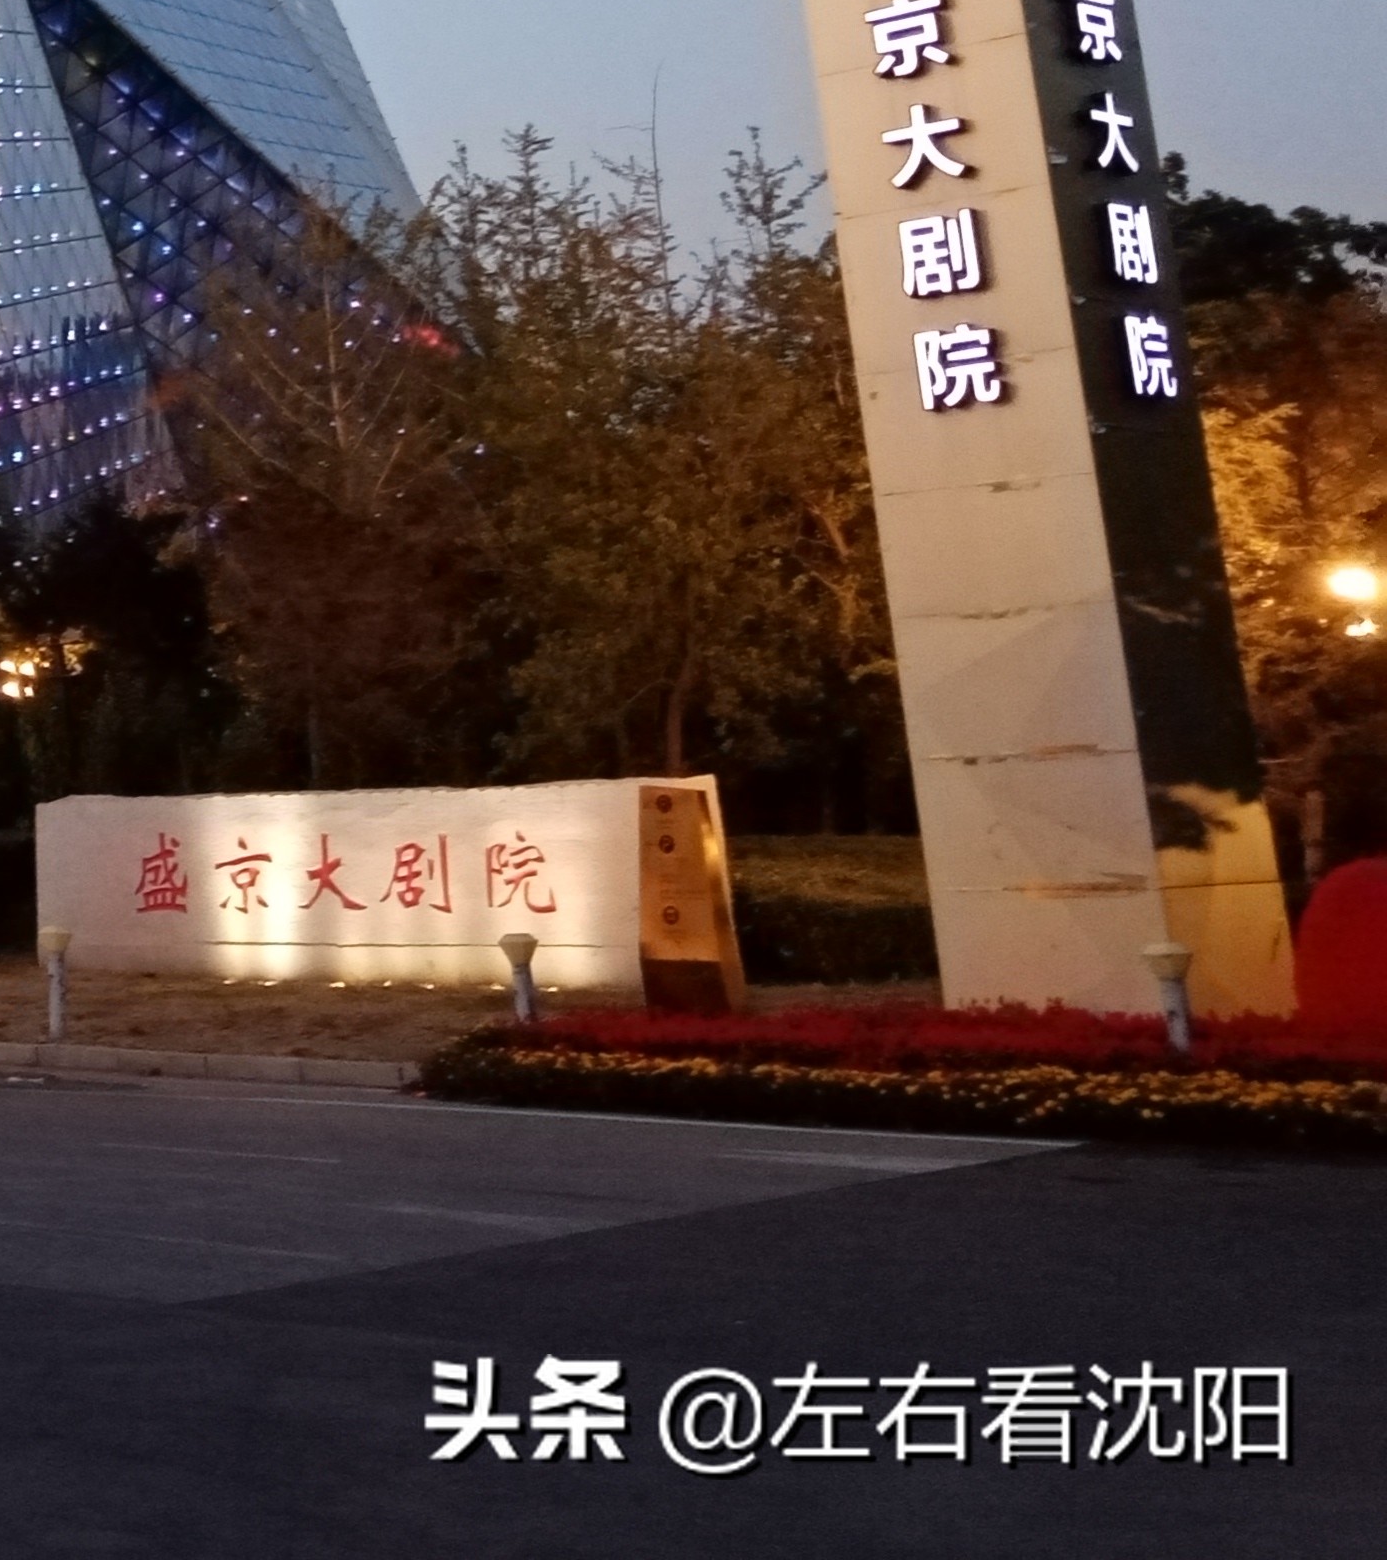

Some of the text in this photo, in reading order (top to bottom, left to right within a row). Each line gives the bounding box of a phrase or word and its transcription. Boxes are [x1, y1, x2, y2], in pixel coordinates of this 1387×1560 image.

[133, 830, 558, 916] 盛京大剧院
